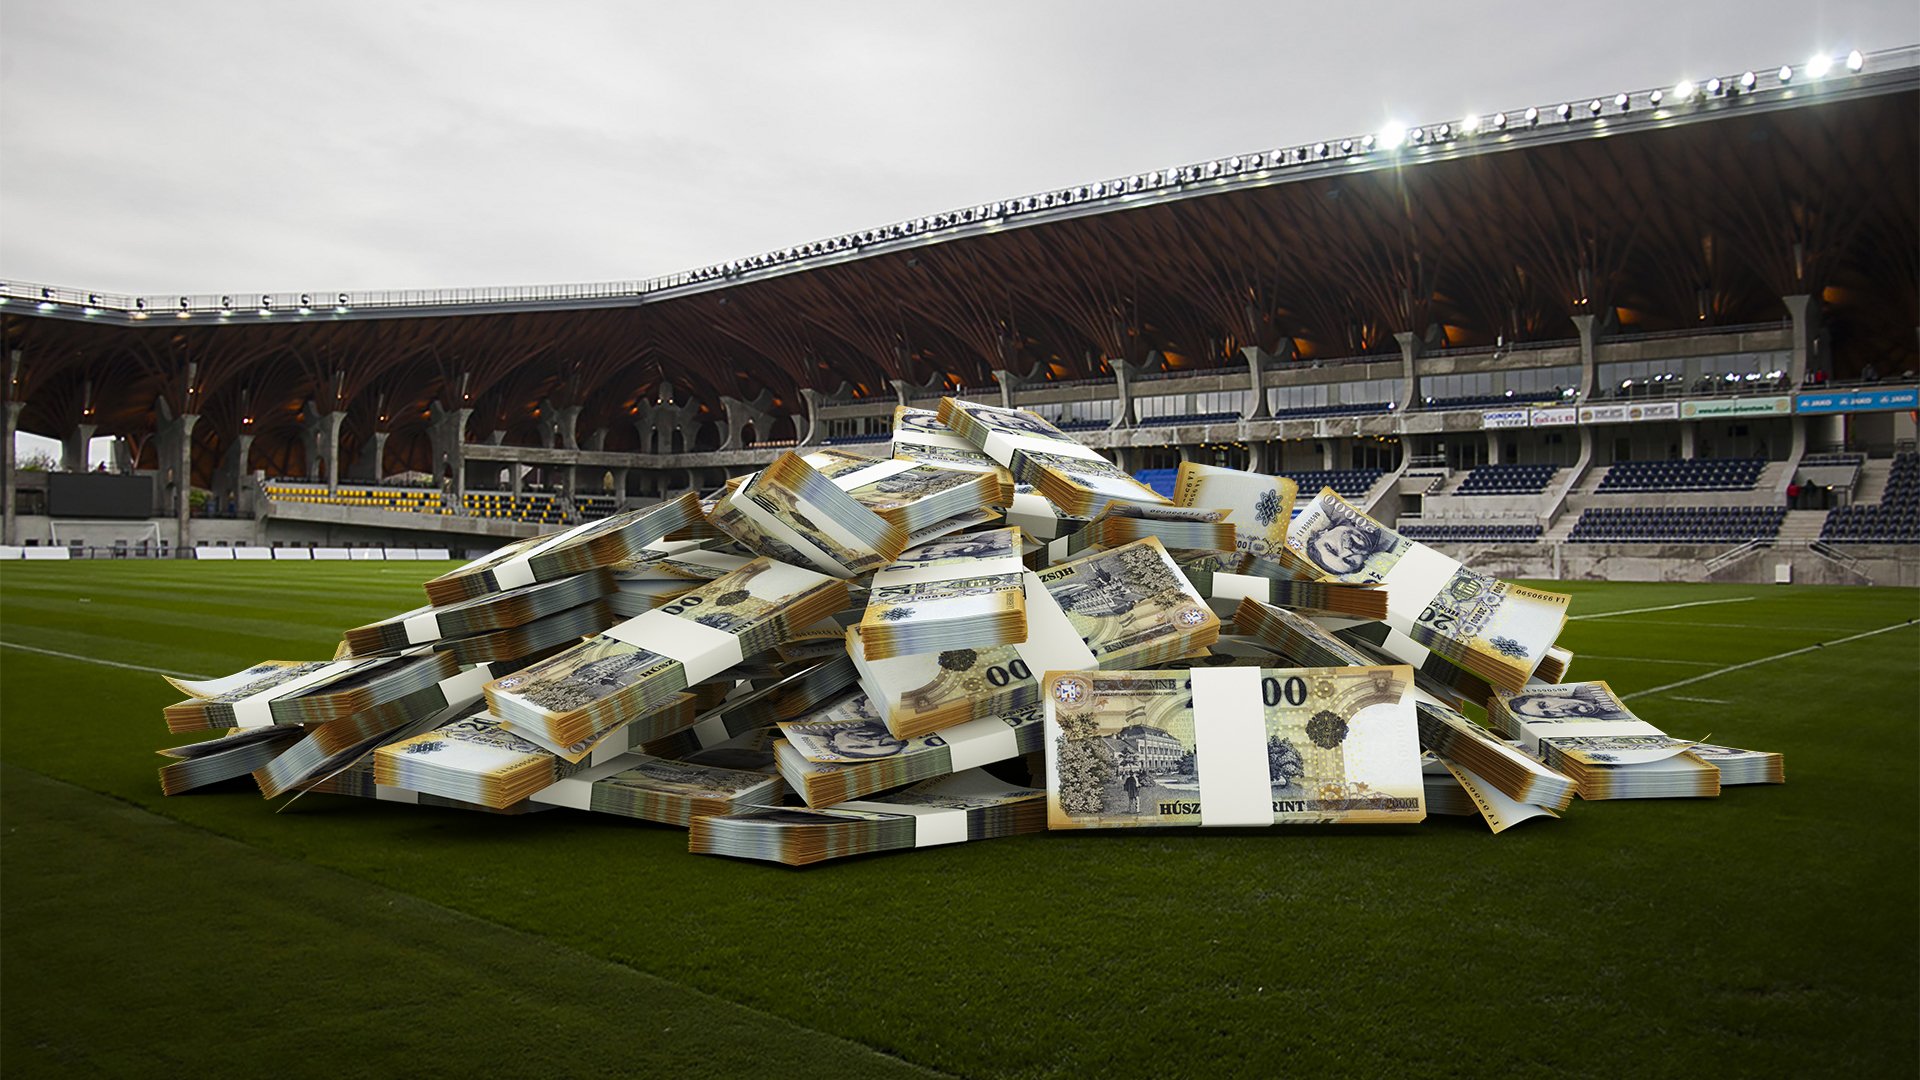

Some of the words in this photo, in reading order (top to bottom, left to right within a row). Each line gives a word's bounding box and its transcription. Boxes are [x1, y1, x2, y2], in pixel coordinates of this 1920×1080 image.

[1811, 399, 1833, 407] JAKO
[1891, 395, 1914, 403] JAKO
[1160, 800, 1201, 815] HÚSZ
